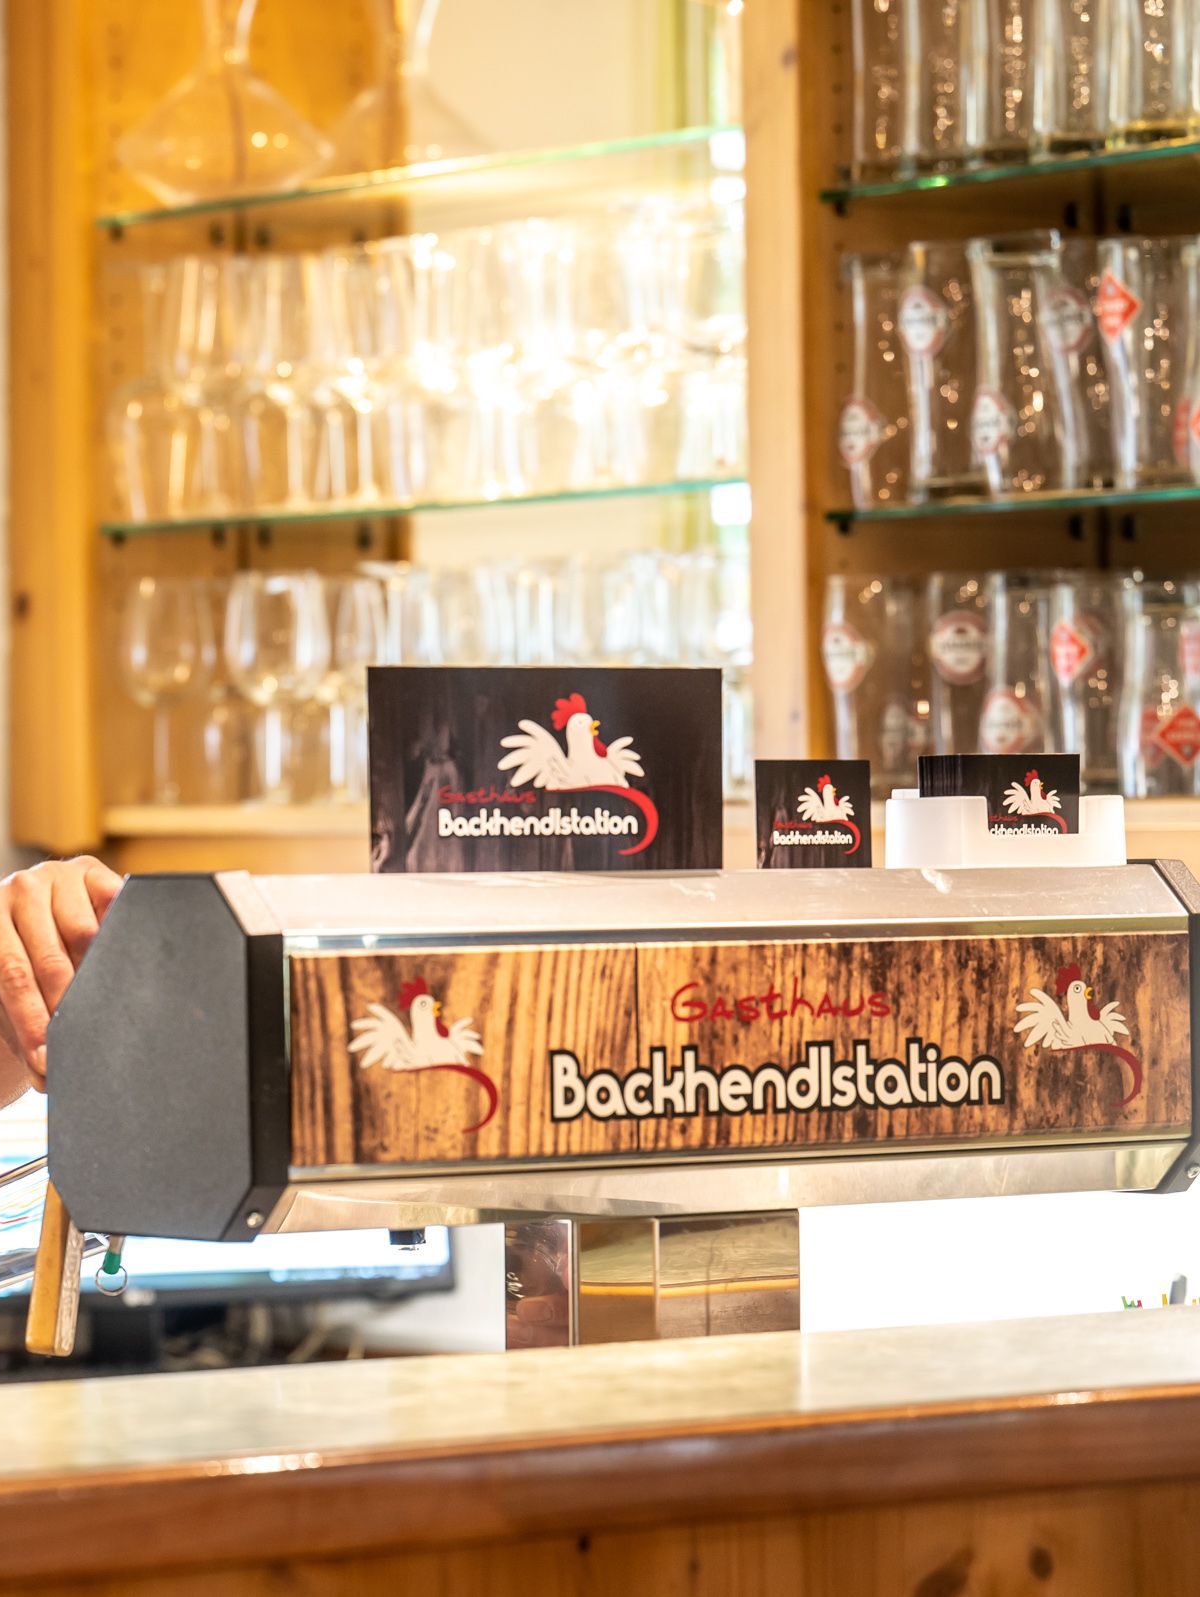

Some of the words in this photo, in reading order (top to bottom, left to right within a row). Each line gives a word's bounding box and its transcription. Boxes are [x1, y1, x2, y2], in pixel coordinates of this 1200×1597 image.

[438, 807, 639, 836] Backhendlstation
[989, 823, 1059, 836] ckhendlstation
[550, 1038, 1004, 1121] Backhendlstation
